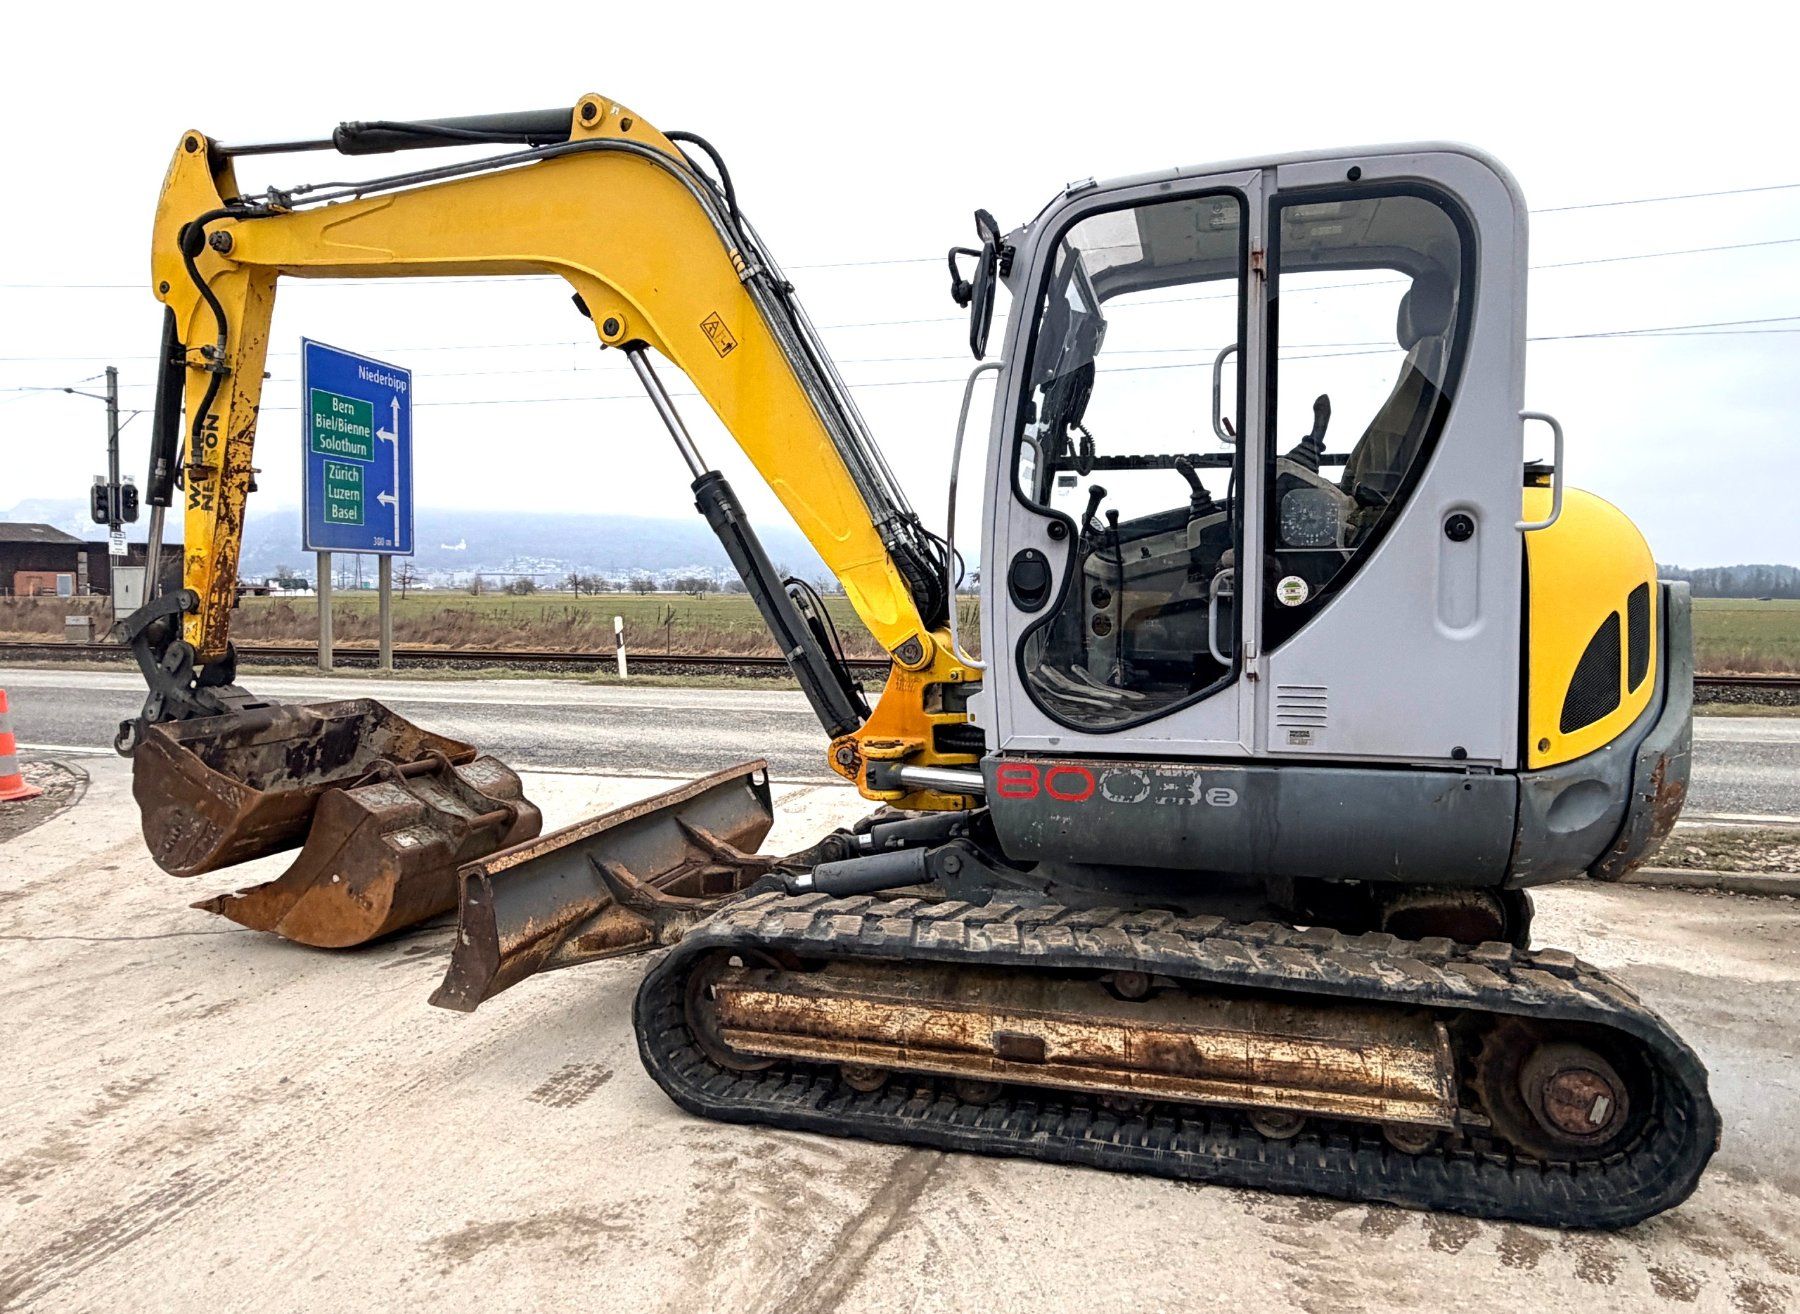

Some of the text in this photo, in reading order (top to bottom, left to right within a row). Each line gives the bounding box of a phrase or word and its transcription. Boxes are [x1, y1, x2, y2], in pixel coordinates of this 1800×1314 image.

[358, 365, 407, 394] Niederbipp
[332, 397, 355, 416] Bern
[315, 413, 371, 438] Biel/Bienne
[319, 434, 367, 456] Solothurn
[328, 464, 359, 483] Zürich
[328, 483, 360, 501] Luzern
[331, 504, 357, 520] Basel
